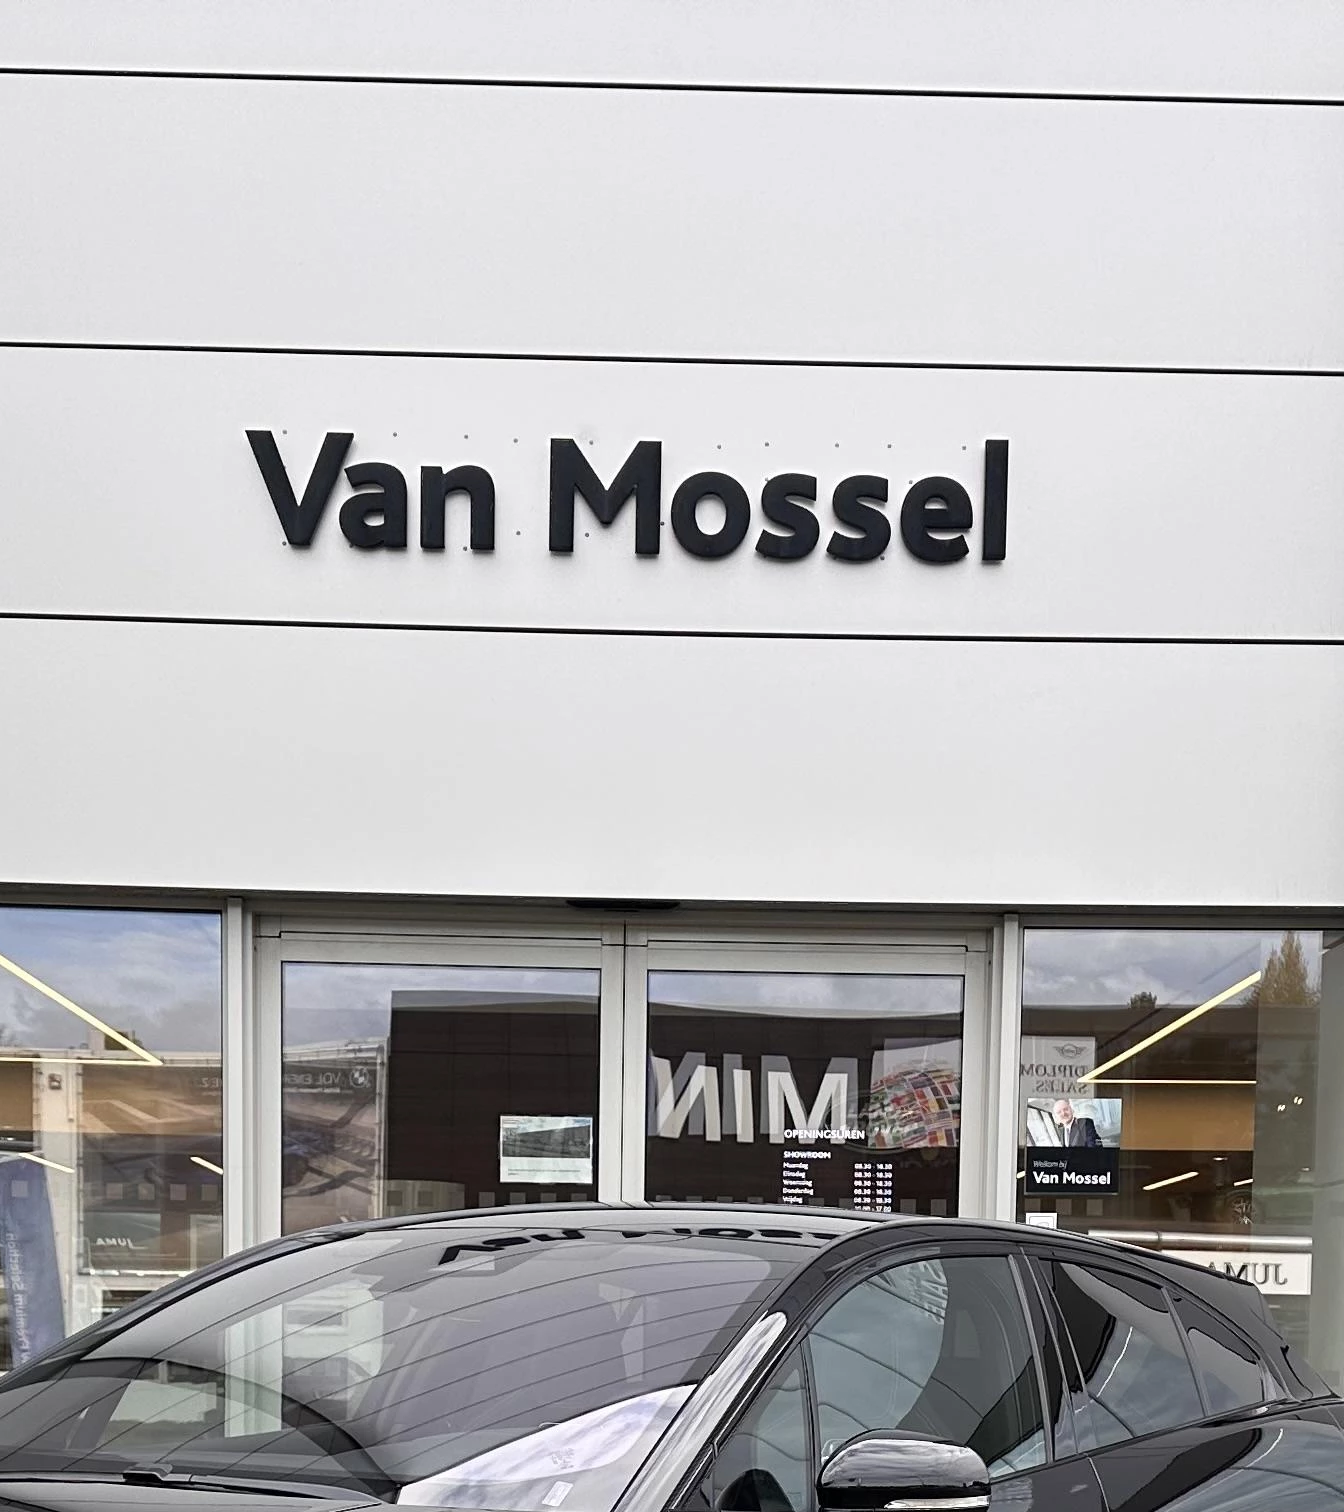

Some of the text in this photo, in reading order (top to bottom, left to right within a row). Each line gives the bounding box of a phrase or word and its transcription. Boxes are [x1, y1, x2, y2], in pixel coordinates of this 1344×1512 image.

[245, 429, 1009, 562] Van Mossel
[783, 1151, 832, 1159] SHOWROOM
[1032, 1171, 1111, 1185] Van Mossel
